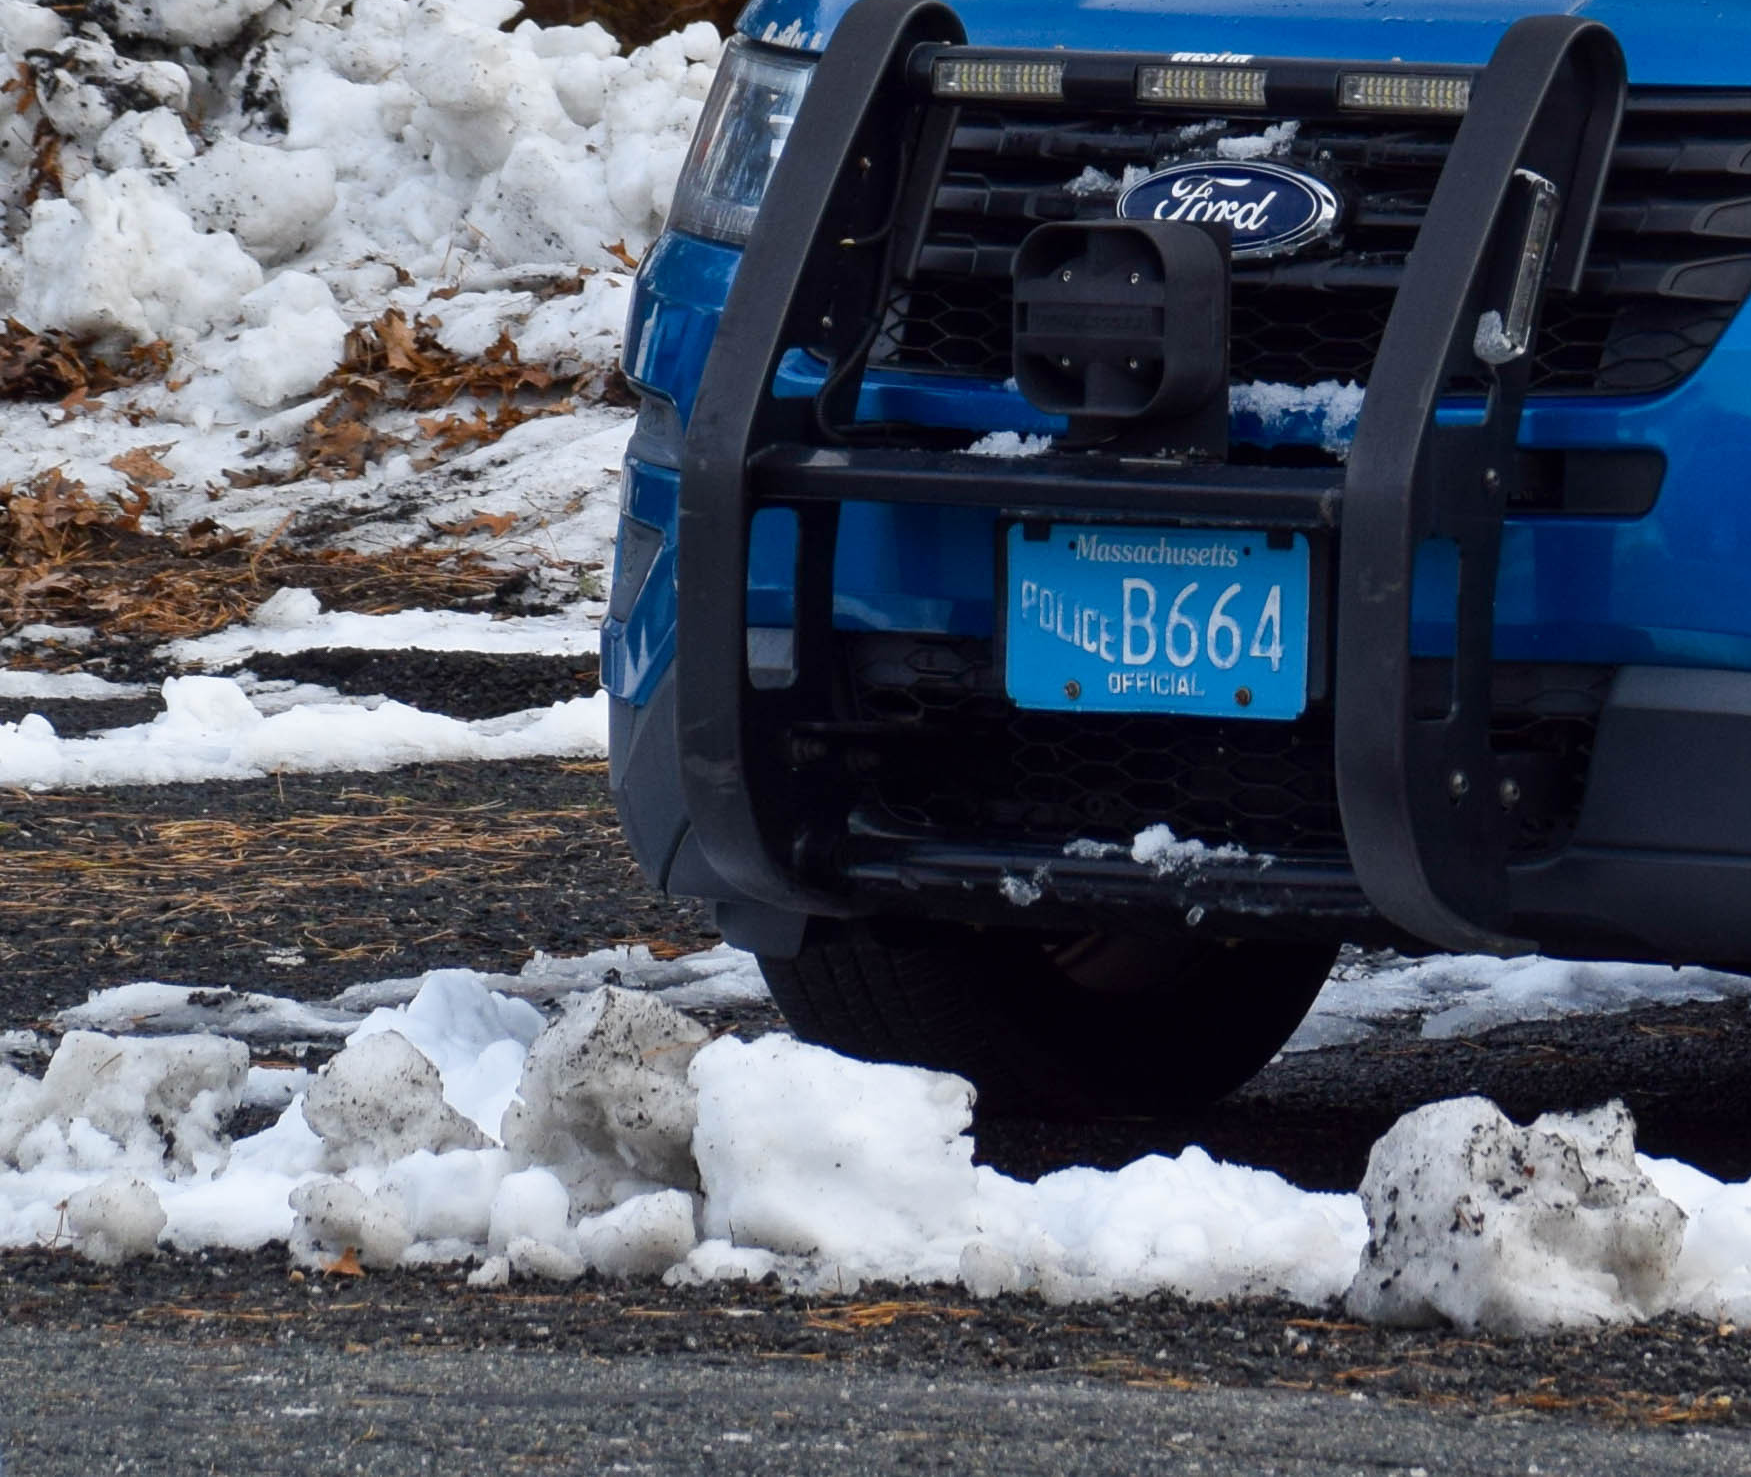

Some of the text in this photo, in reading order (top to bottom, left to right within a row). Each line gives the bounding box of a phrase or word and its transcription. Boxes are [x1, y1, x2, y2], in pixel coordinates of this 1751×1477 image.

[1154, 175, 1278, 231] Ford
[1074, 533, 1239, 568] Massachusetts
[1021, 577, 1285, 672] POLICE B664
[1108, 672, 1206, 697] OFFICIAL
